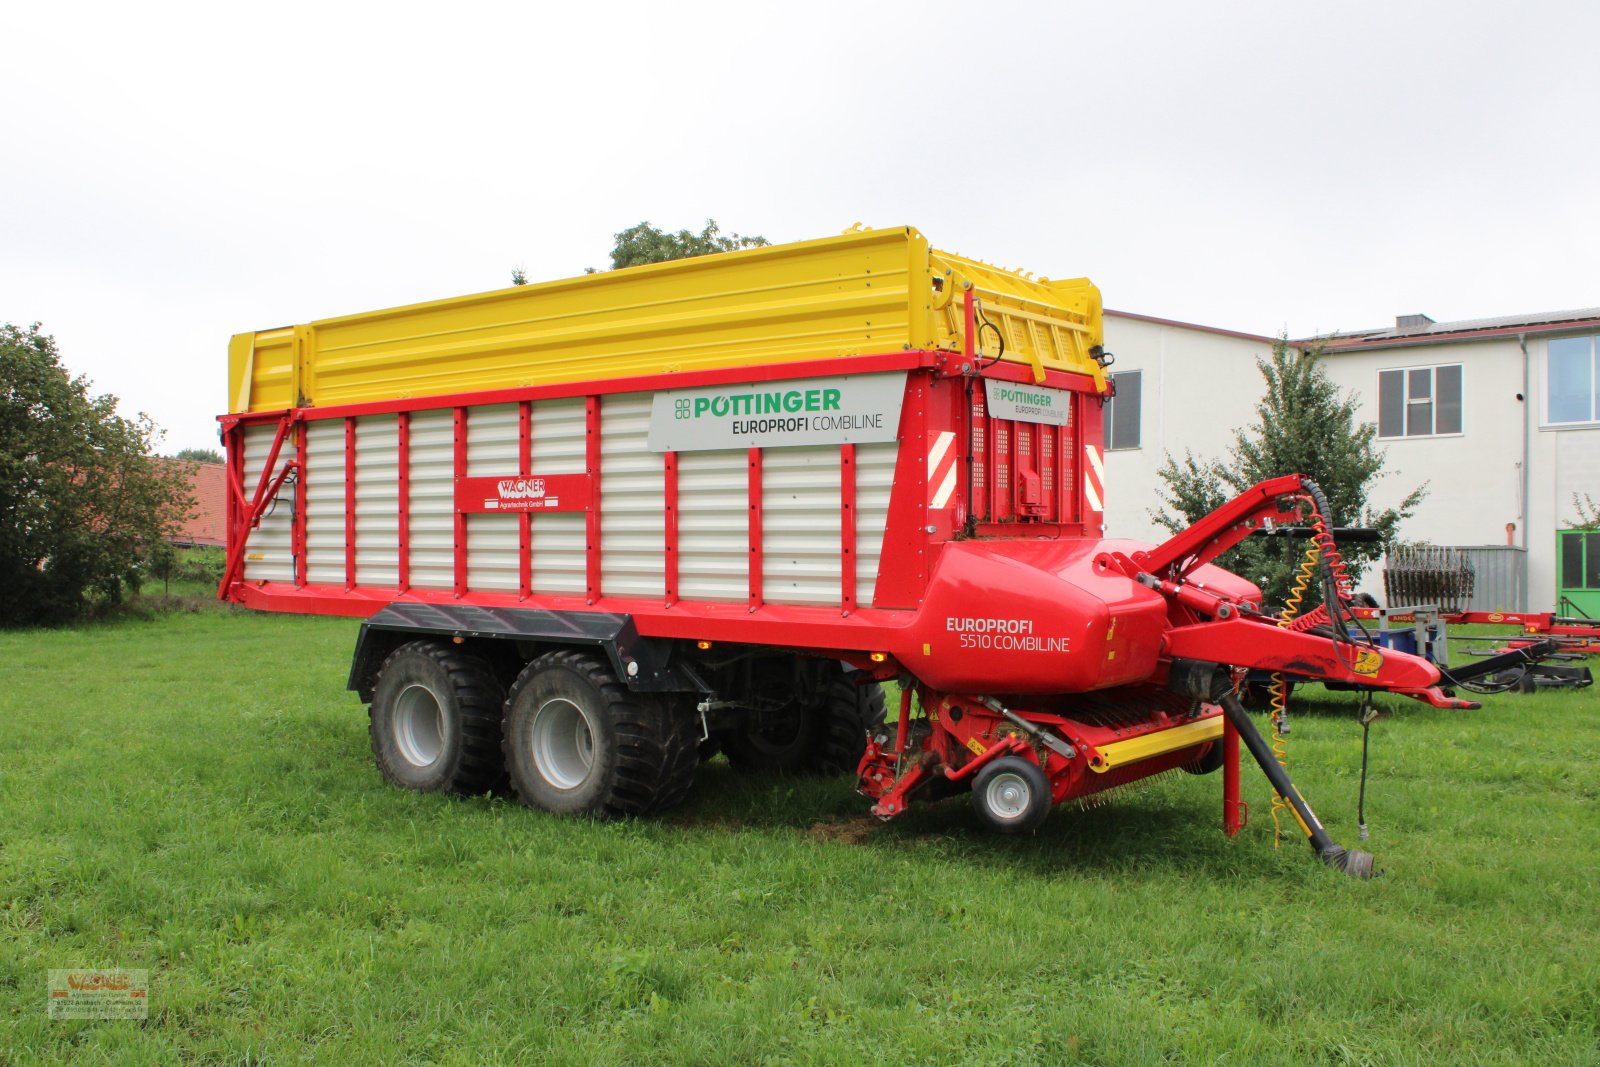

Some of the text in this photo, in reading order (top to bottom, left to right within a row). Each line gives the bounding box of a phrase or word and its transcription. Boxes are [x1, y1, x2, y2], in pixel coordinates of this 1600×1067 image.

[694, 388, 841, 418] PÖTTINGER
[732, 413, 883, 434] EUROPROFI COMBILINE
[499, 479, 545, 496] WAGNER
[500, 501, 528, 510] Agrartechnik
[946, 617, 1033, 634] EUROPROFI
[960, 633, 1071, 653] 5510 COMBILINE
